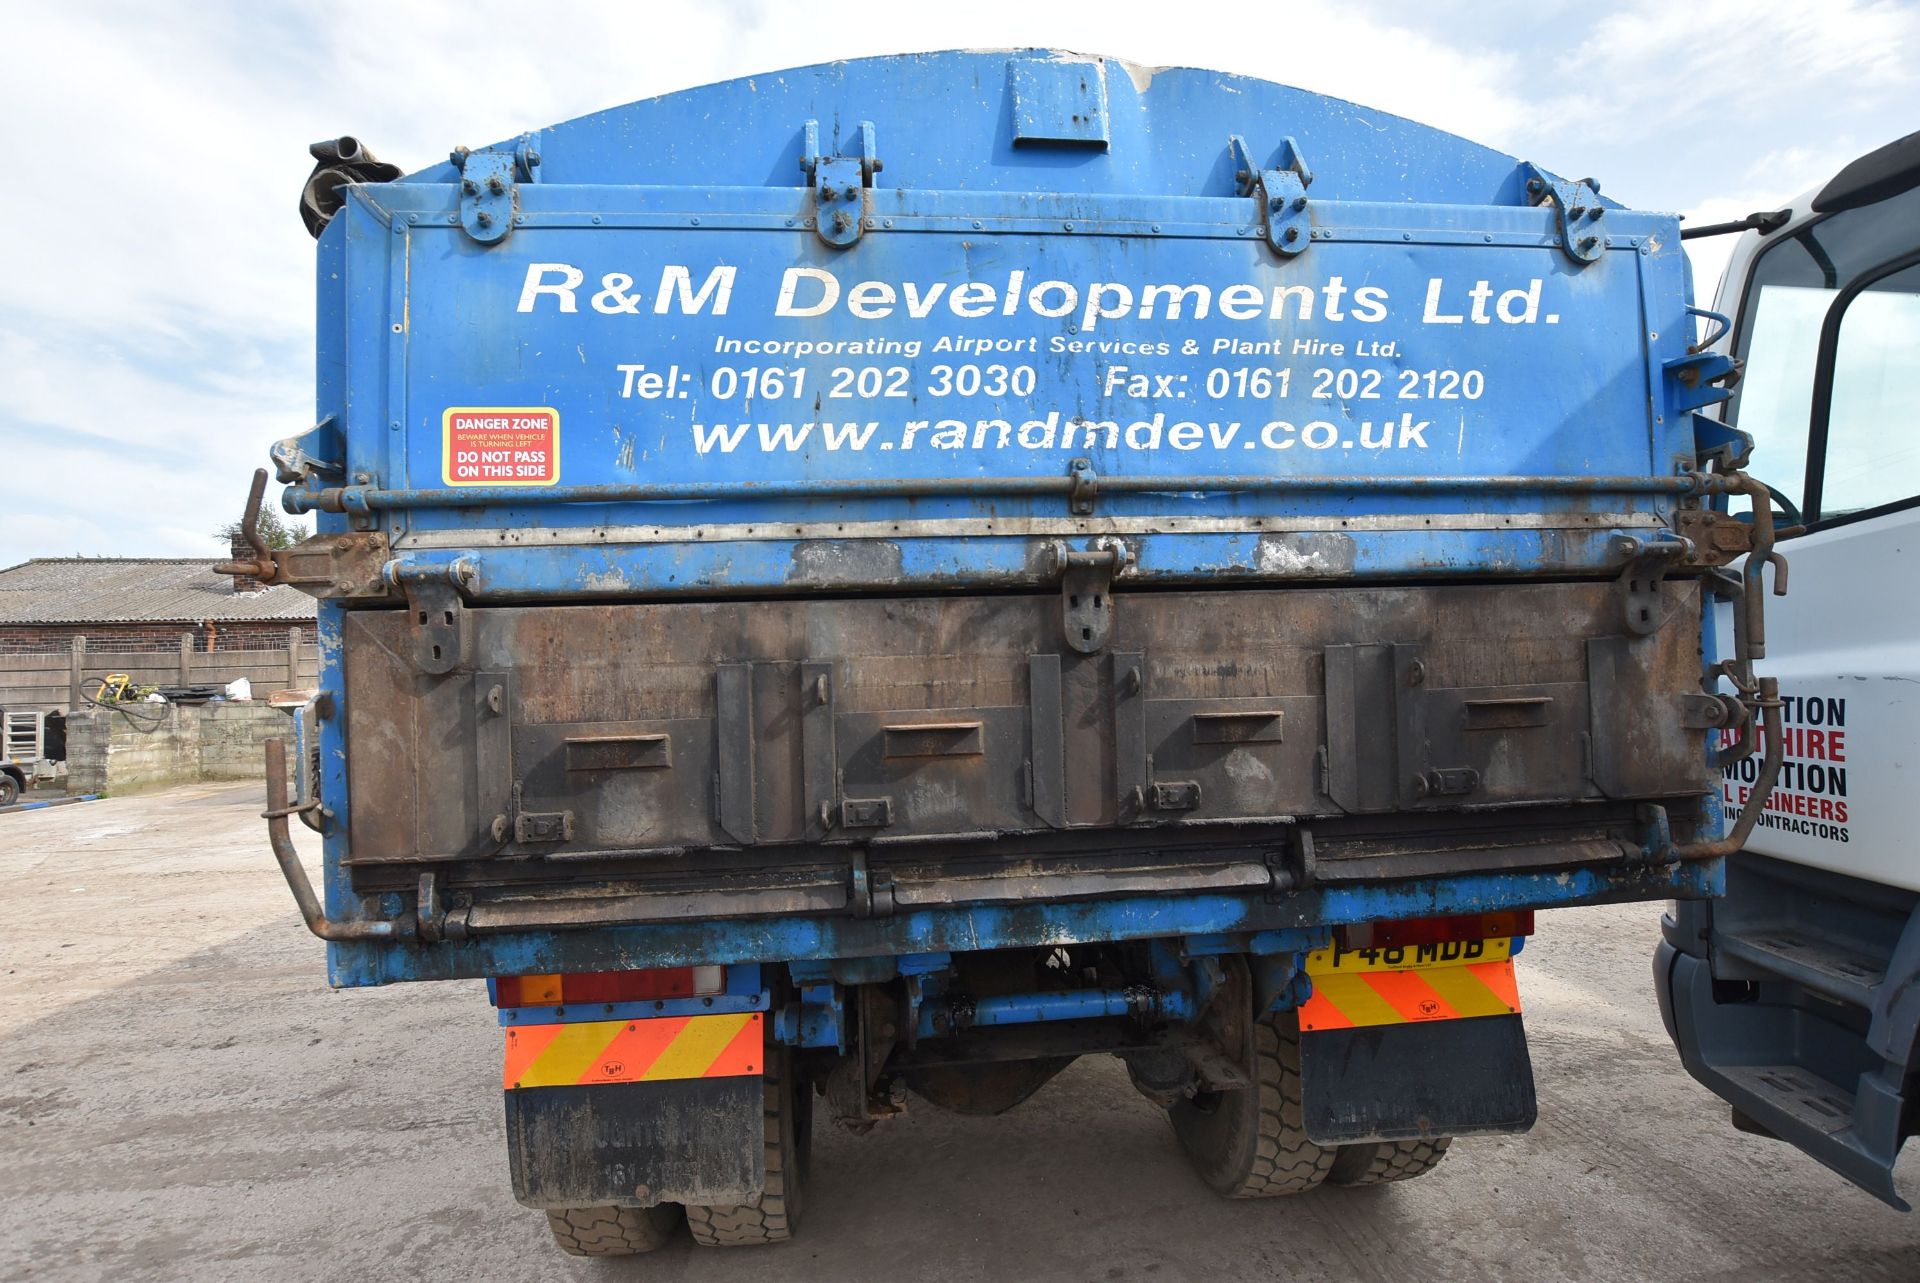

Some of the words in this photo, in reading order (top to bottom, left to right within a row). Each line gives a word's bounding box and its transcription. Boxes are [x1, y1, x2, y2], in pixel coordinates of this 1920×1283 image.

[516, 263, 738, 315] R&M
[774, 267, 1389, 331] Developments
[1422, 278, 1560, 325] Ltd.
[715, 335, 922, 358] Incorporating
[932, 336, 1038, 358] Airport
[1049, 336, 1170, 356] Services
[1181, 338, 1200, 356] &
[1212, 338, 1282, 356] Plant
[1291, 338, 1345, 357] Hire
[1356, 340, 1402, 358] Ltd.
[616, 364, 691, 399] Tel:
[711, 366, 806, 400] 0161
[828, 366, 910, 399] 202
[927, 364, 1037, 398] 3030
[1103, 365, 1189, 399] Fax:
[1206, 367, 1291, 399] 0161
[1311, 367, 1383, 400] 202
[1397, 369, 1486, 400] 2120
[456, 418, 510, 430] DANGER
[511, 418, 549, 430] ZONE
[693, 411, 1430, 455] www.randmdev.co.uk
[457, 433, 488, 441] BEWARE
[489, 433, 514, 441] WHEN
[470, 440, 477, 448] IS
[478, 440, 514, 448] TURNING
[515, 440, 532, 448] LEFT
[457, 451, 478, 463] DO
[481, 451, 511, 463] NOT
[514, 451, 546, 463] PASS
[457, 465, 479, 477] ON
[482, 465, 513, 477] THIS
[516, 465, 546, 477] SIDE
[1722, 756, 1847, 797] MOTION
[1756, 813, 1849, 843] ONTRACTORS
